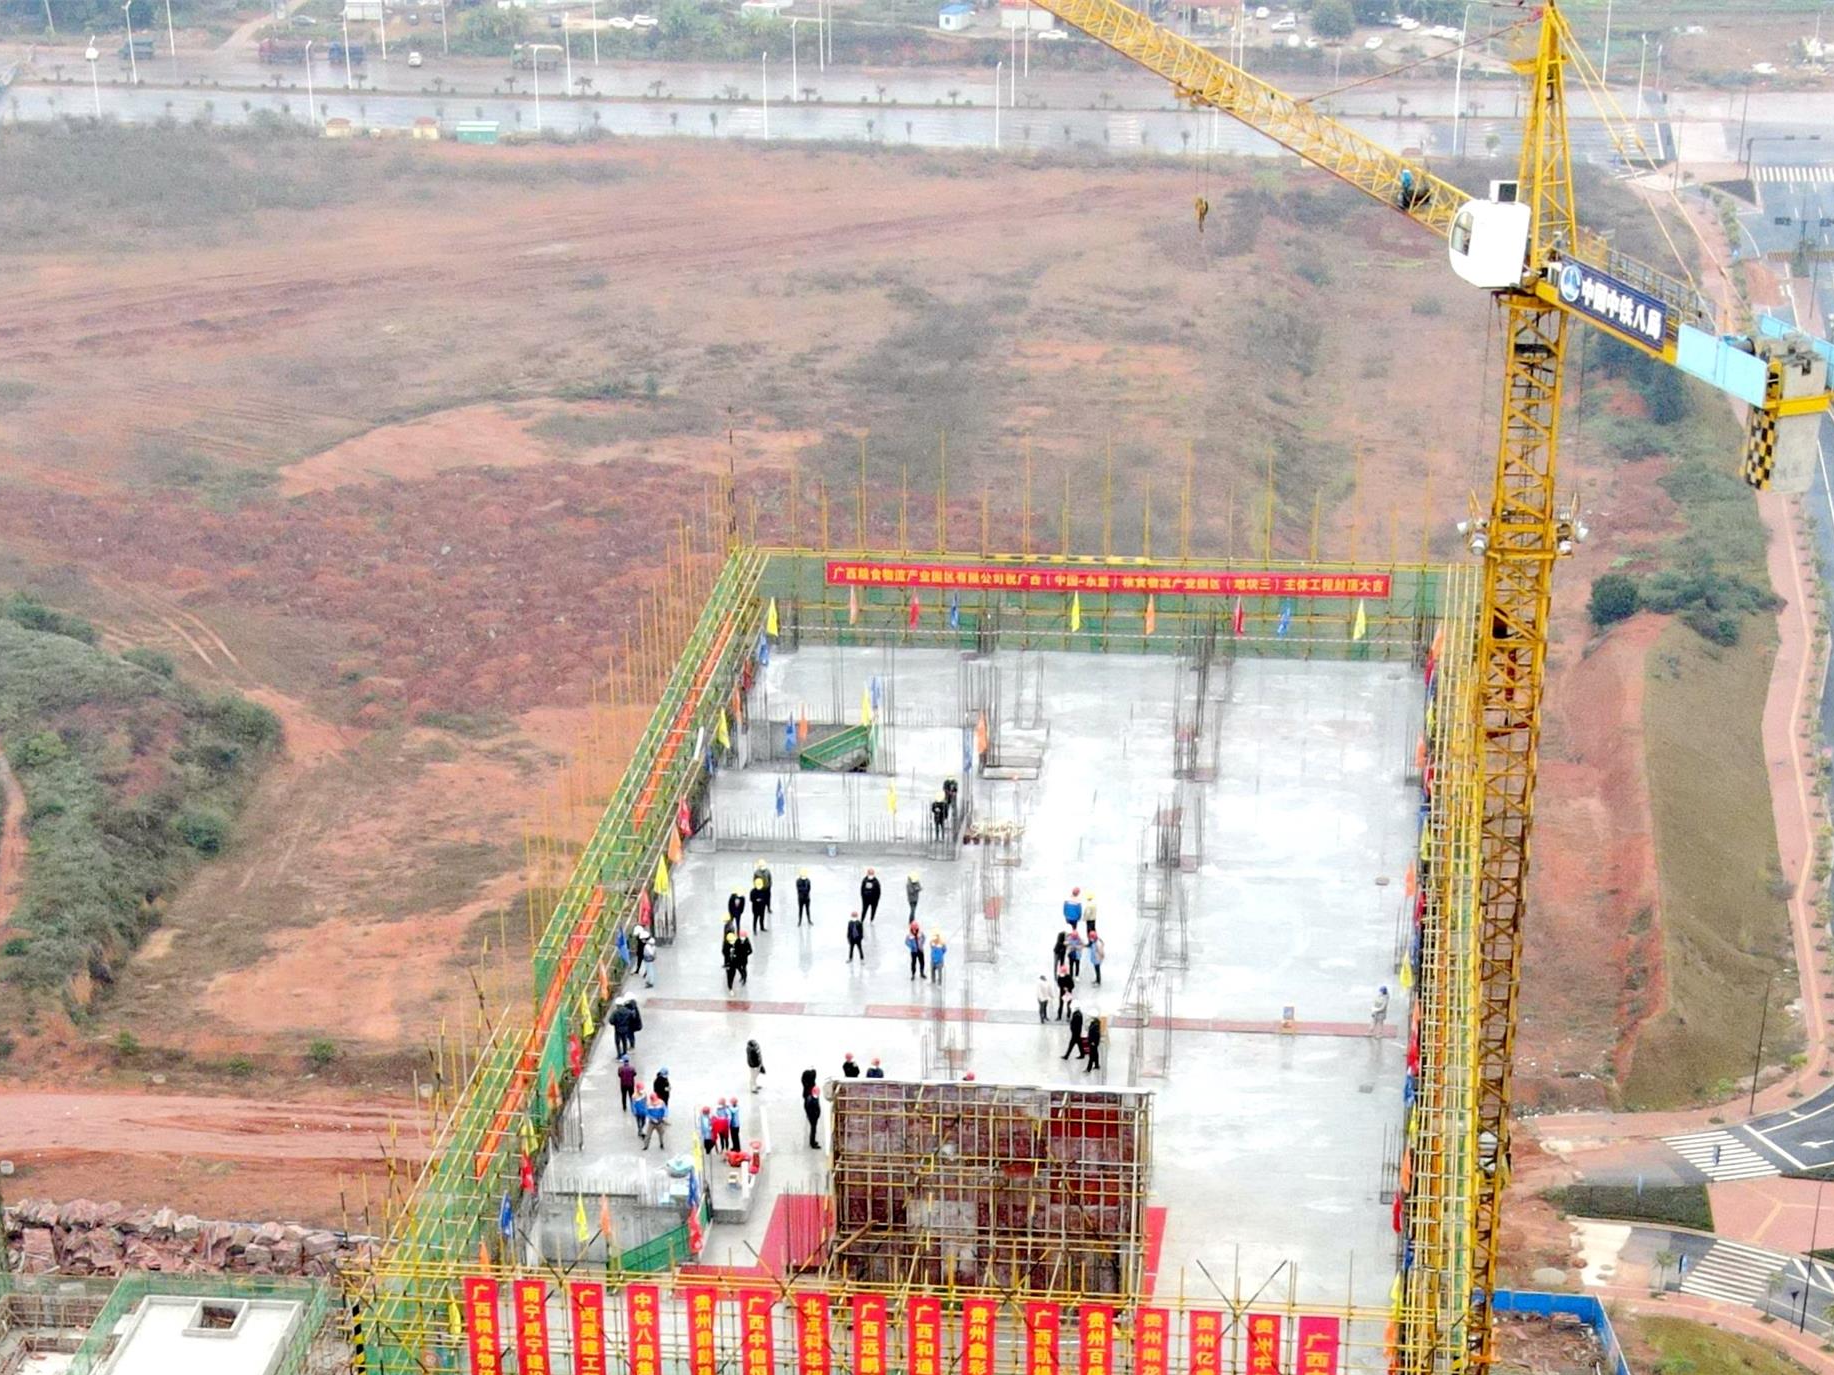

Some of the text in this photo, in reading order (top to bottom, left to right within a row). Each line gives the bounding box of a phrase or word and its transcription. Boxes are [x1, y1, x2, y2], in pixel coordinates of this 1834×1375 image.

[1579, 277, 1664, 342] 中国中铁八局
